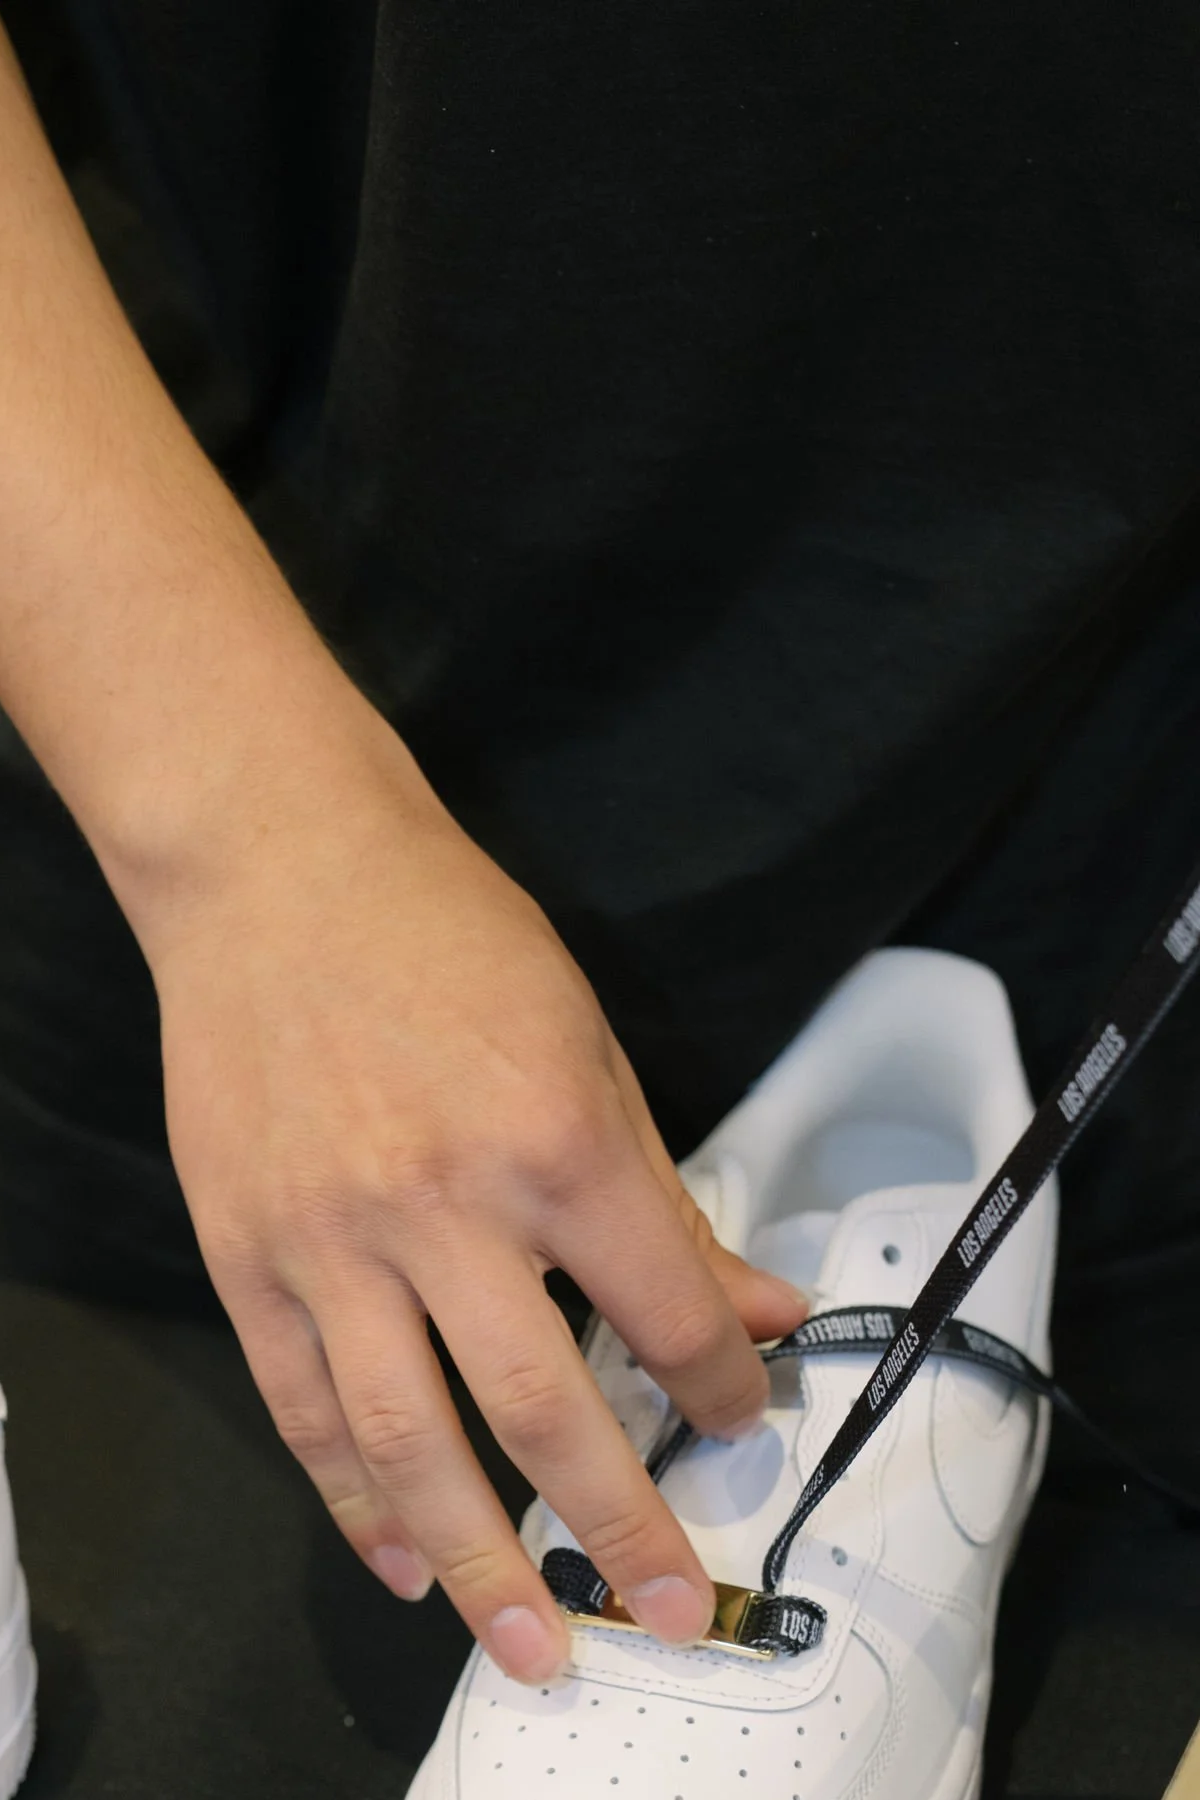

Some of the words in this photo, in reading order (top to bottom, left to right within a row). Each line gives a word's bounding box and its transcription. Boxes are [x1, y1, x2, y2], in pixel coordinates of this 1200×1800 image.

[1057, 1081, 1086, 1123] LOS
[1075, 1023, 1126, 1096] ANGELES
[957, 1230, 981, 1268] LOS
[973, 1177, 1018, 1245] ANGELES
[863, 1312, 895, 1340] LOS
[867, 1374, 887, 1411] LOS
[882, 1322, 920, 1388] ANGELES
[780, 1609, 810, 1644] LOS
